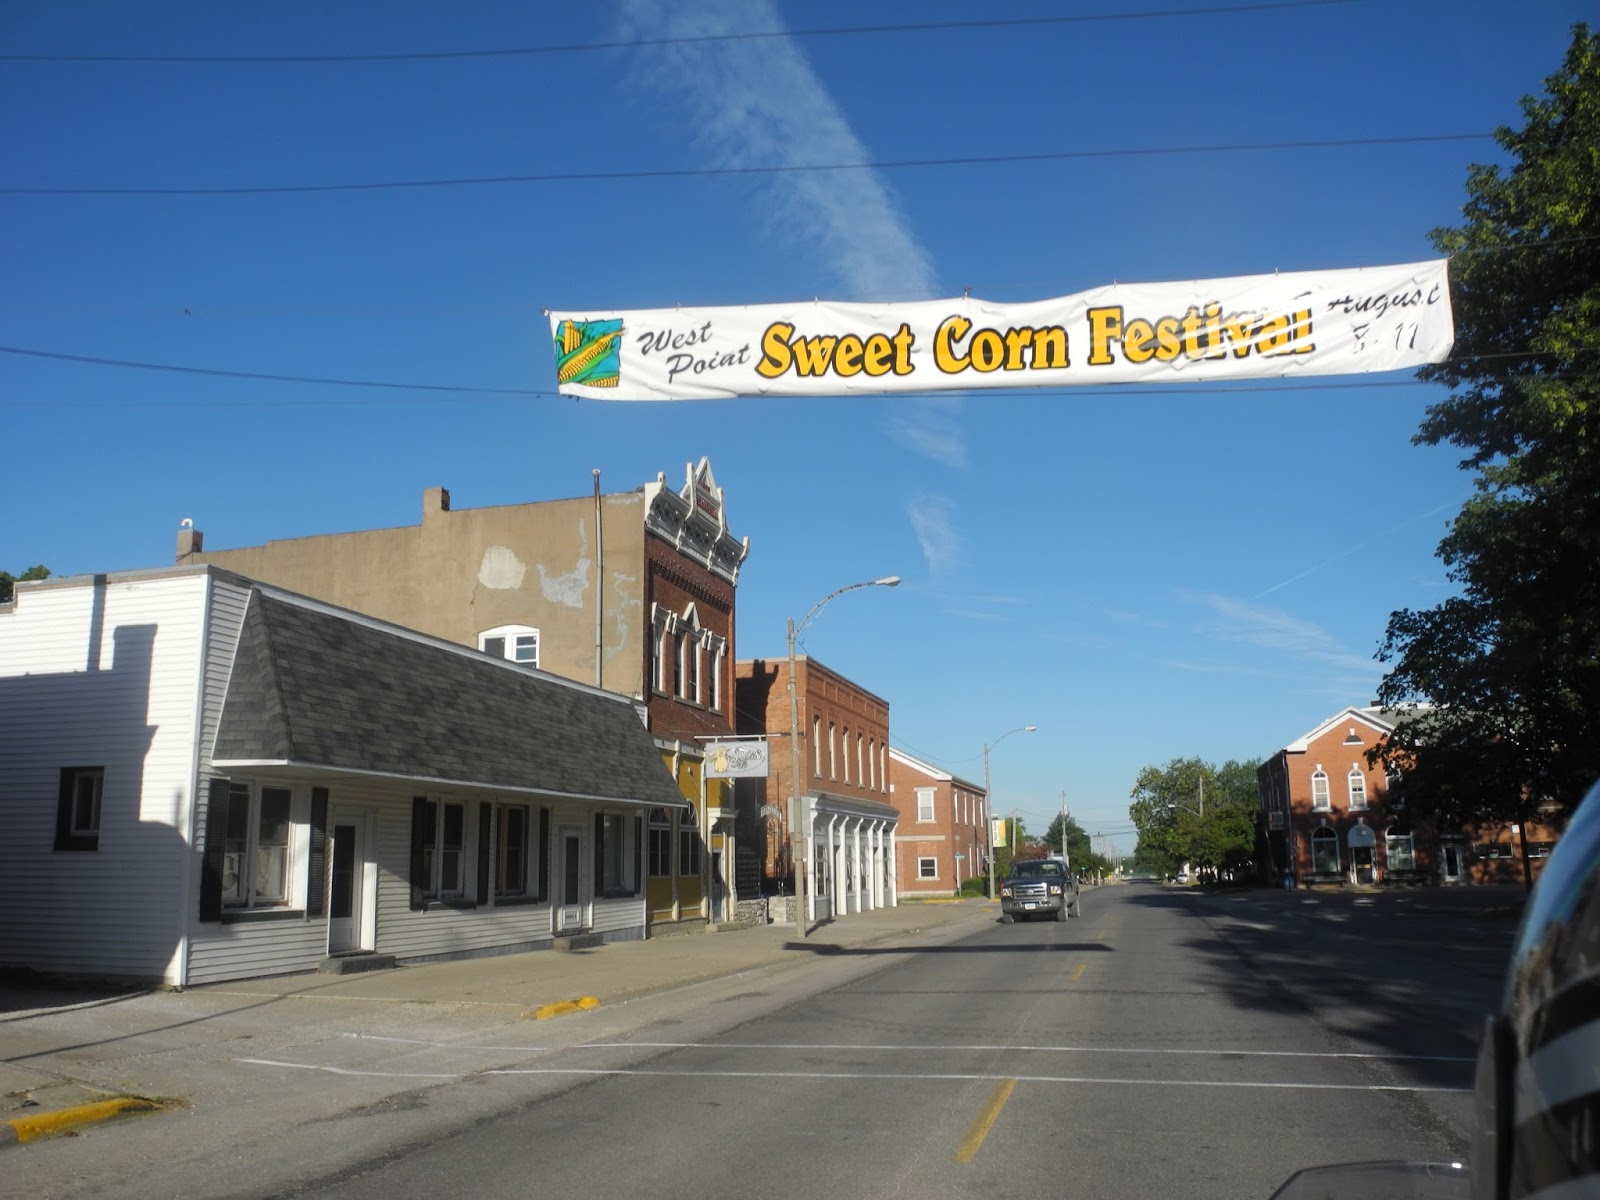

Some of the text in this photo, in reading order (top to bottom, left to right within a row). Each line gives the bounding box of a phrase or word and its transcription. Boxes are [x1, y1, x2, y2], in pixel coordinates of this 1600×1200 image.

[1327, 282, 1440, 319] August
[636, 320, 713, 355] West
[754, 291, 1316, 379] Sweet Corn Festival
[666, 344, 750, 384] Point
